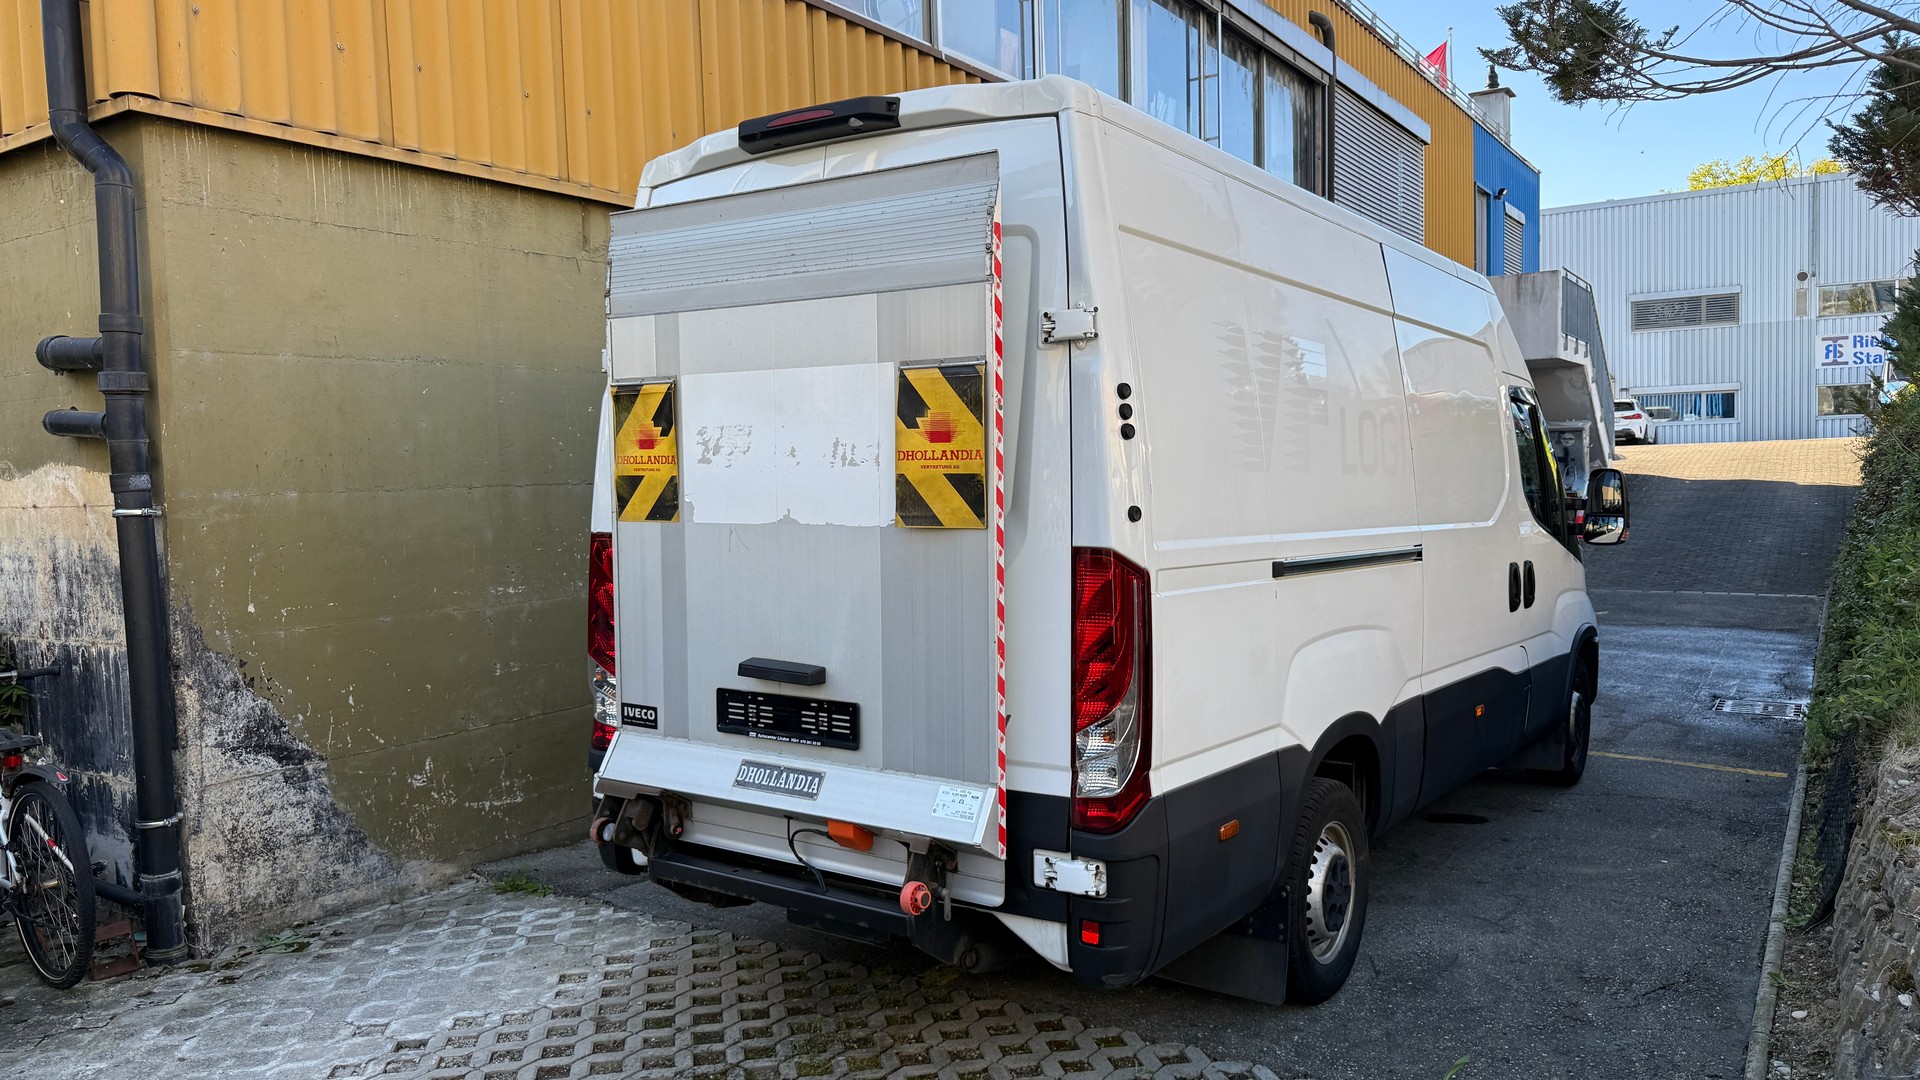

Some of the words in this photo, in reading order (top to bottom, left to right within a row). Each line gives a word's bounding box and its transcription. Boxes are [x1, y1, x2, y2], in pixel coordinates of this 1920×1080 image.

[616, 455, 676, 465] DHOLLANDIA
[897, 449, 983, 461] DHOLLANDIA
[624, 706, 655, 720] IVECO
[737, 766, 819, 793] DHOLLANDIA
